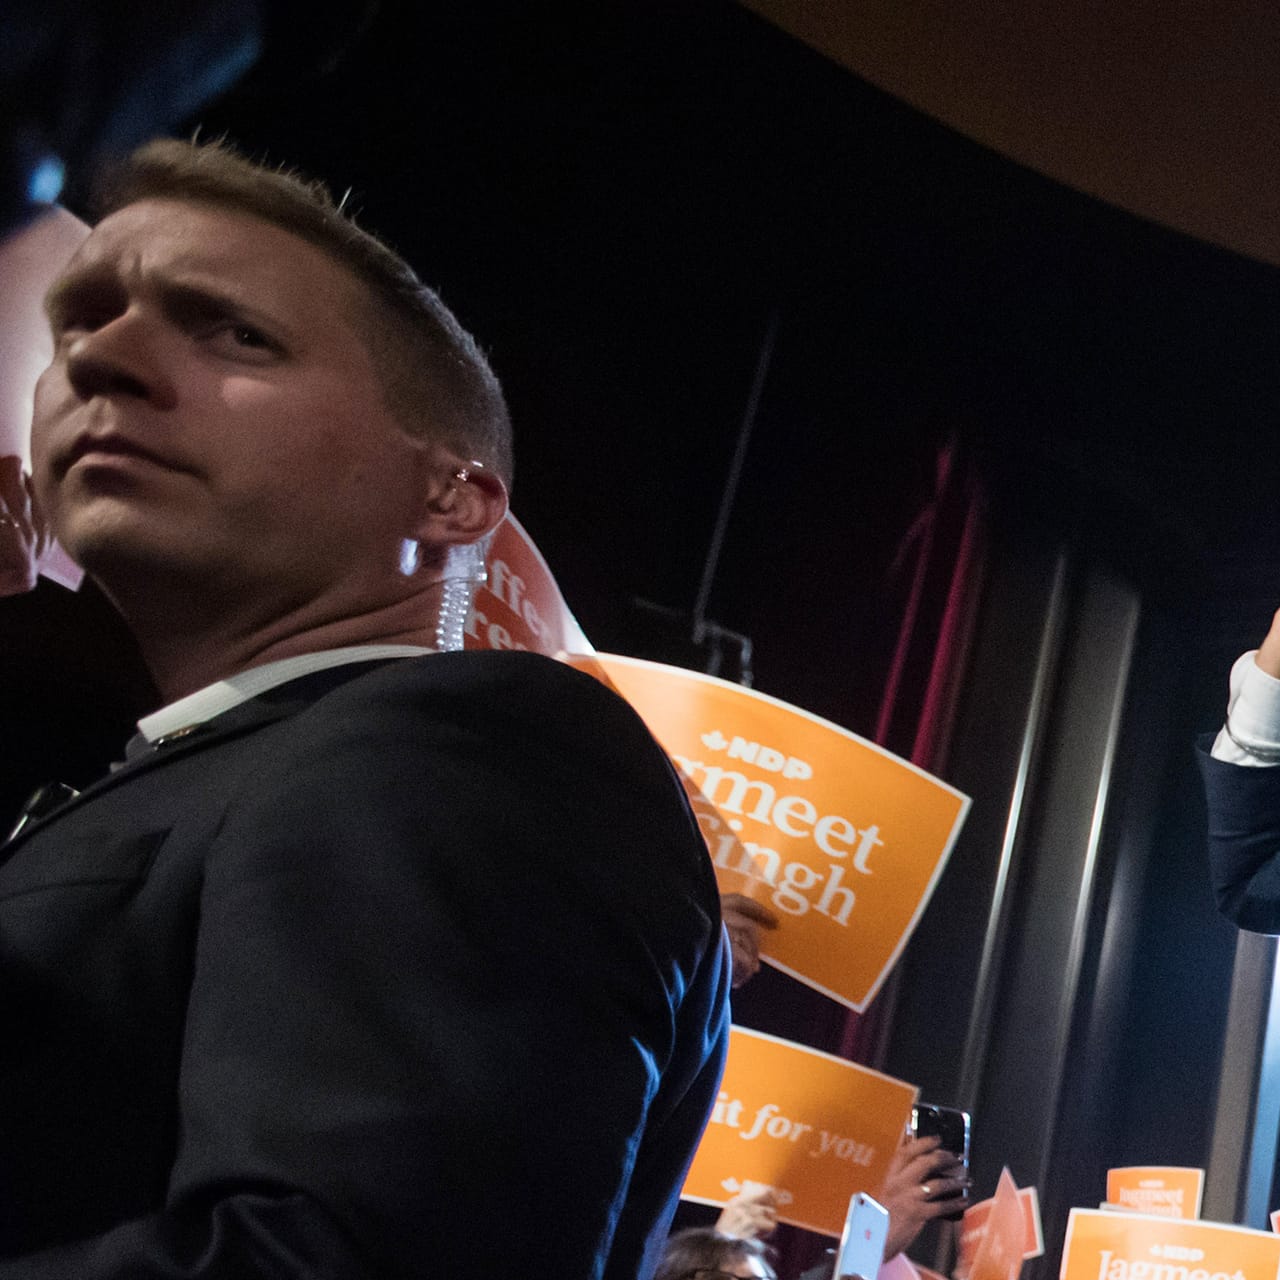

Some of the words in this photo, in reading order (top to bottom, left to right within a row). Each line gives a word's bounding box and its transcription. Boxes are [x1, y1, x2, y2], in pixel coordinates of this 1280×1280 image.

[727, 736, 813, 780] NDP
[673, 754, 885, 875] meet
[710, 1091, 743, 1128] it
[739, 1103, 813, 1142] for
[809, 1131, 874, 1167] you
